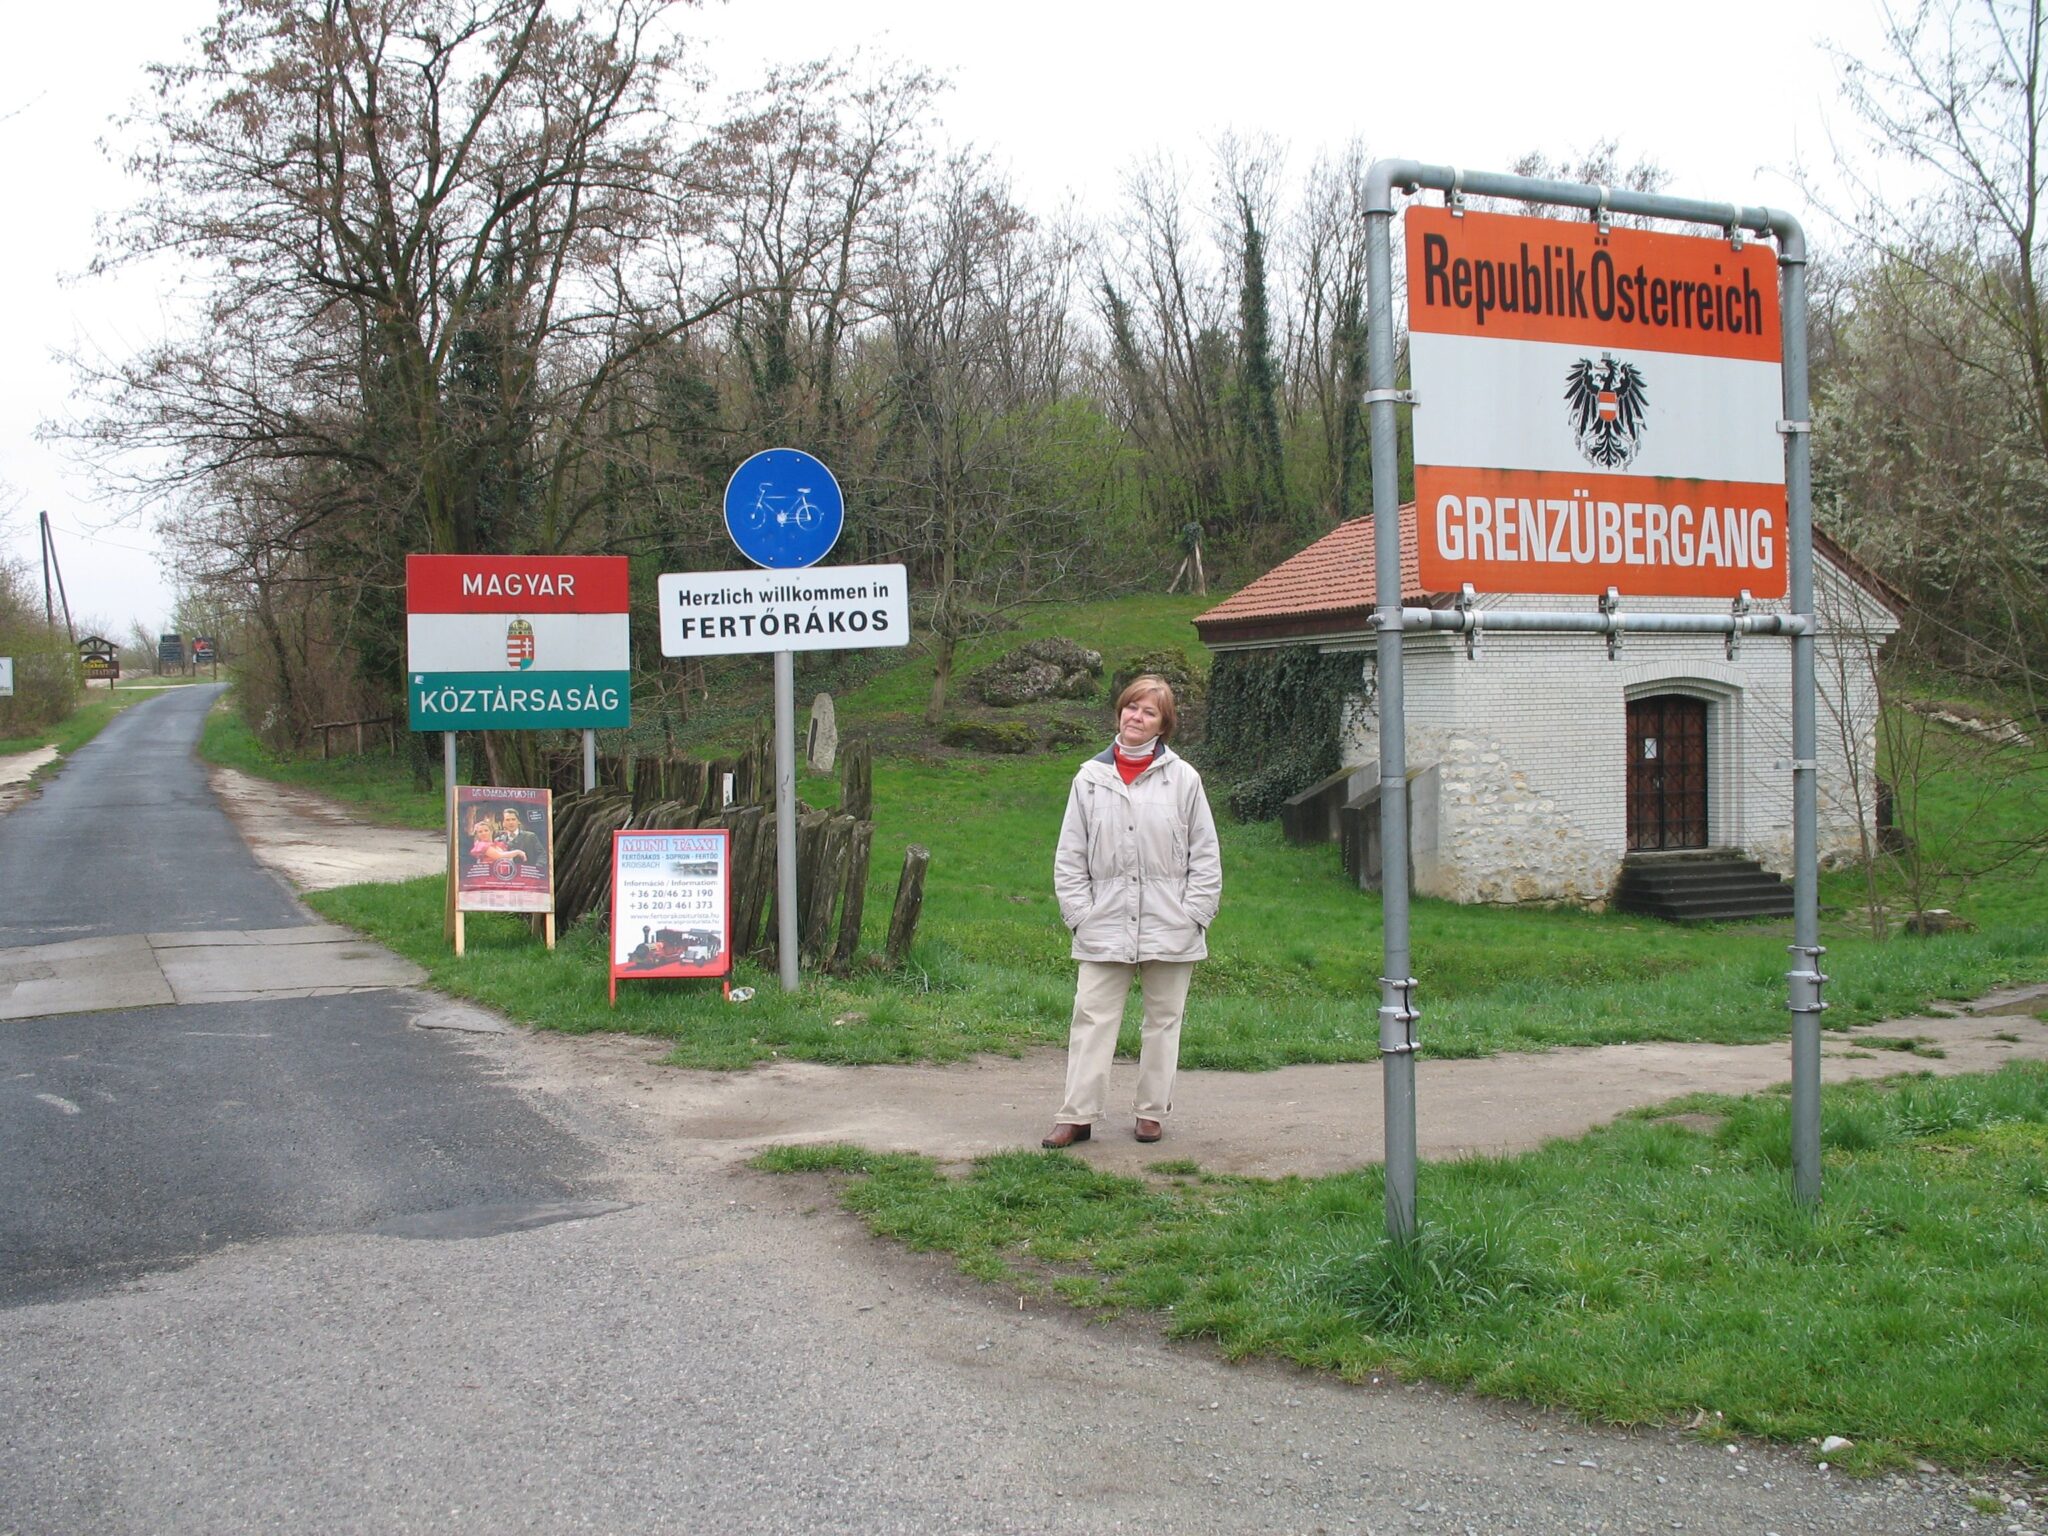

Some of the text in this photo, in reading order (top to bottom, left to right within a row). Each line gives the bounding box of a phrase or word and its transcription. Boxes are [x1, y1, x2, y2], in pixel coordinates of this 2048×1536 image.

[1436, 489, 1774, 569] GRENZÜBERGANG
[462, 573, 576, 596] MAGYAR
[678, 582, 889, 606] Herzlich willkommen in
[681, 606, 889, 639] FERTŐRÁKOS
[420, 684, 619, 713] KÖZTÁRSASÁG
[622, 838, 718, 851] MINI TAXI
[697, 889, 713, 897] 190
